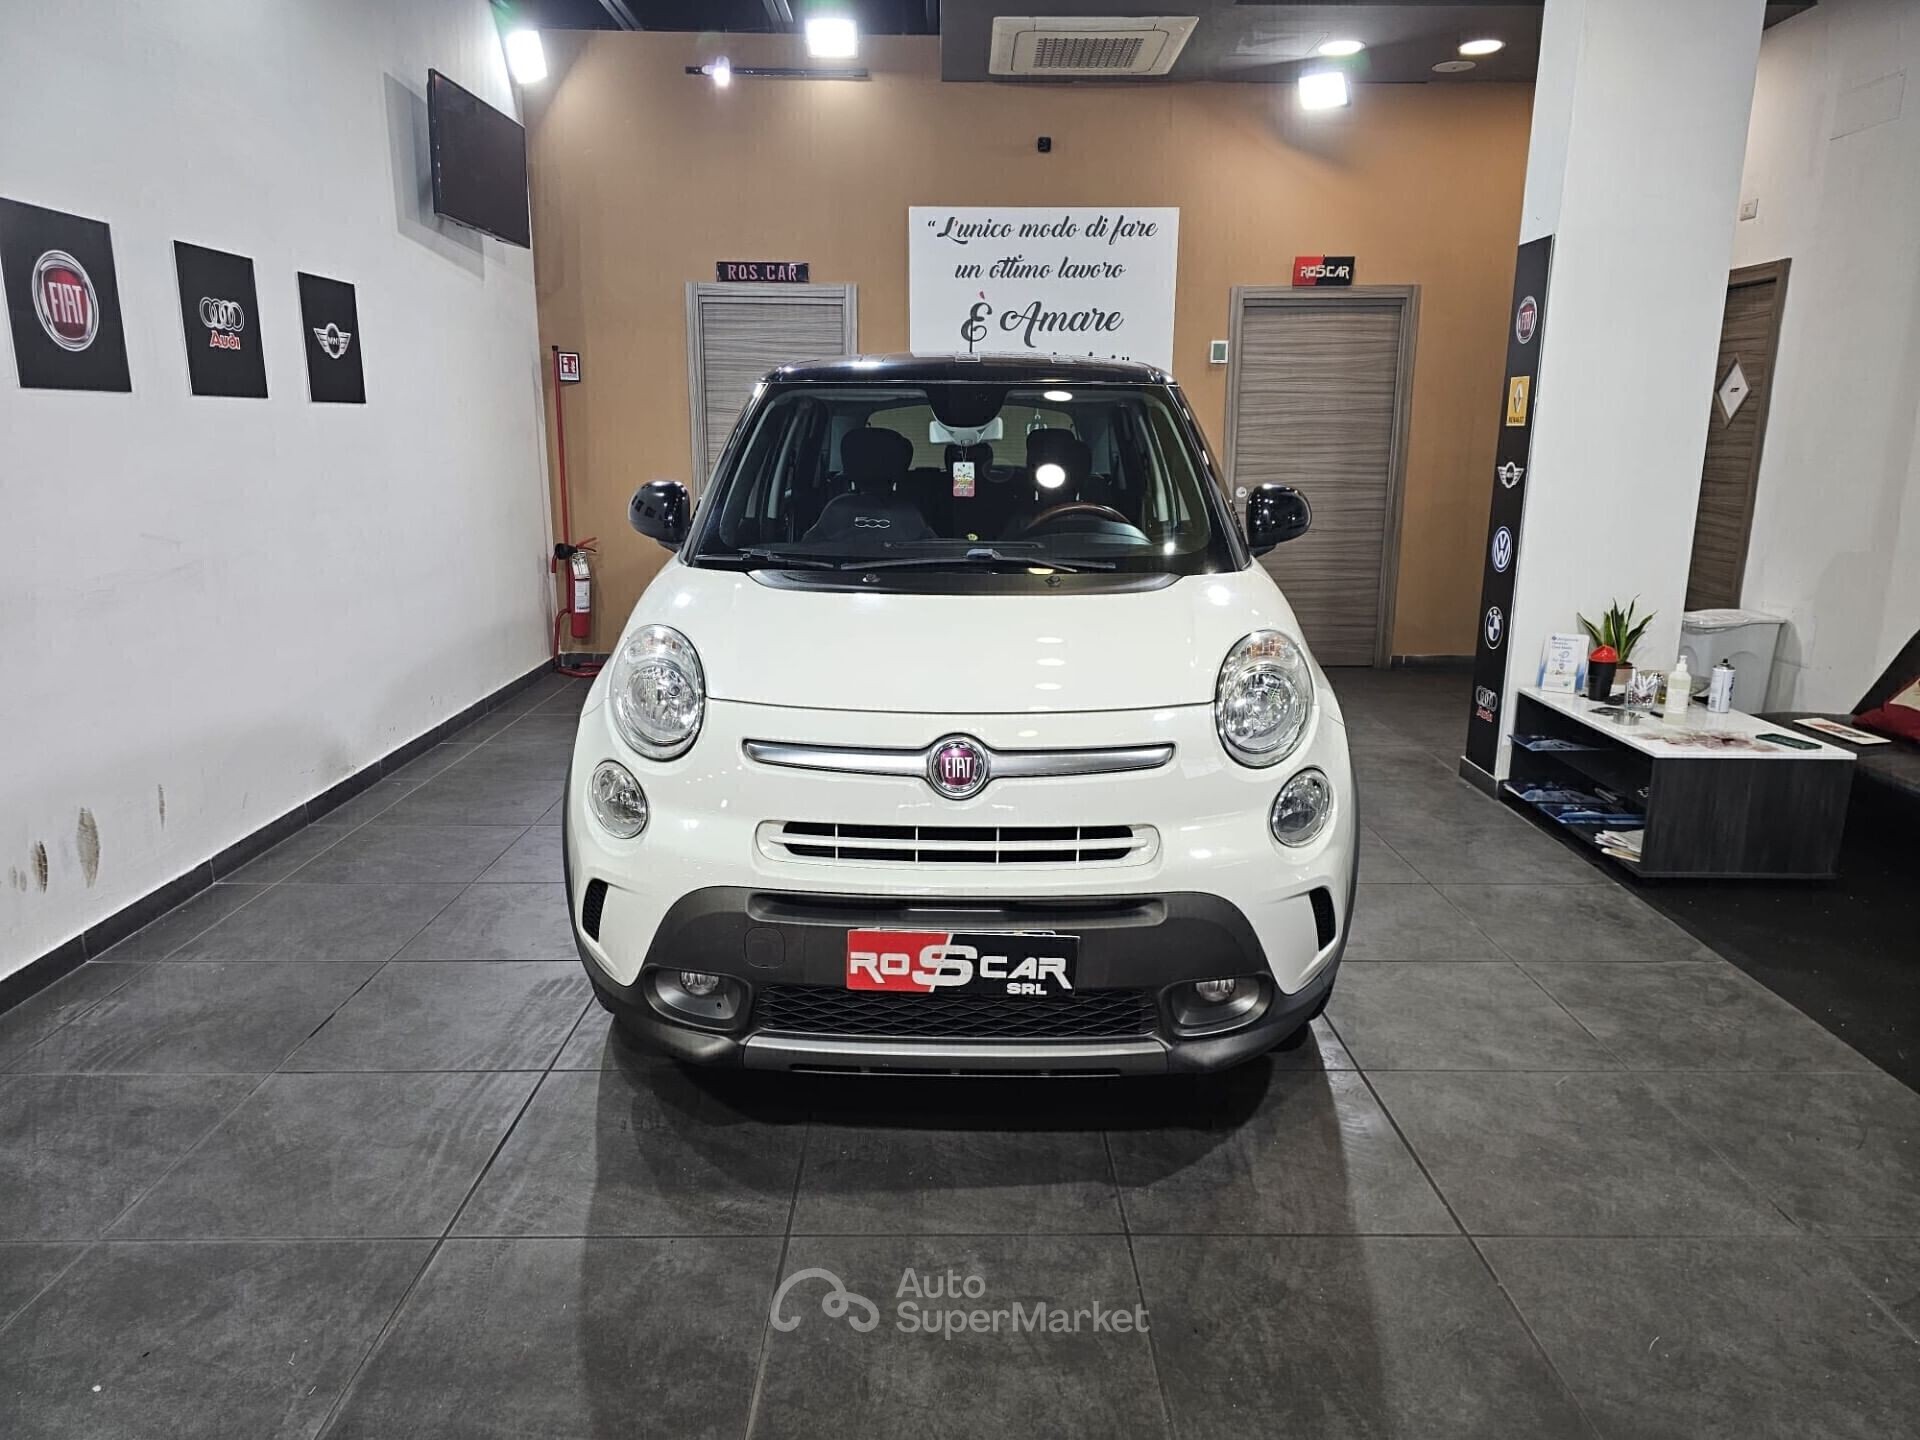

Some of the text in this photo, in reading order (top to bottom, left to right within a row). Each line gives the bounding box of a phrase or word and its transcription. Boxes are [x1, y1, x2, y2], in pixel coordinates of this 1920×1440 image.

[1018, 215, 1080, 238] modo
[1085, 214, 1108, 238] di
[1108, 214, 1158, 246] fare
[727, 264, 797, 281] ROS.CAR
[954, 254, 1127, 279] un ottimo lavoro
[48, 281, 84, 326] FIAT
[999, 301, 1124, 349] Amare
[209, 329, 241, 351] Audi
[944, 756, 973, 779] FIAT
[1006, 982, 1047, 996] SRL
